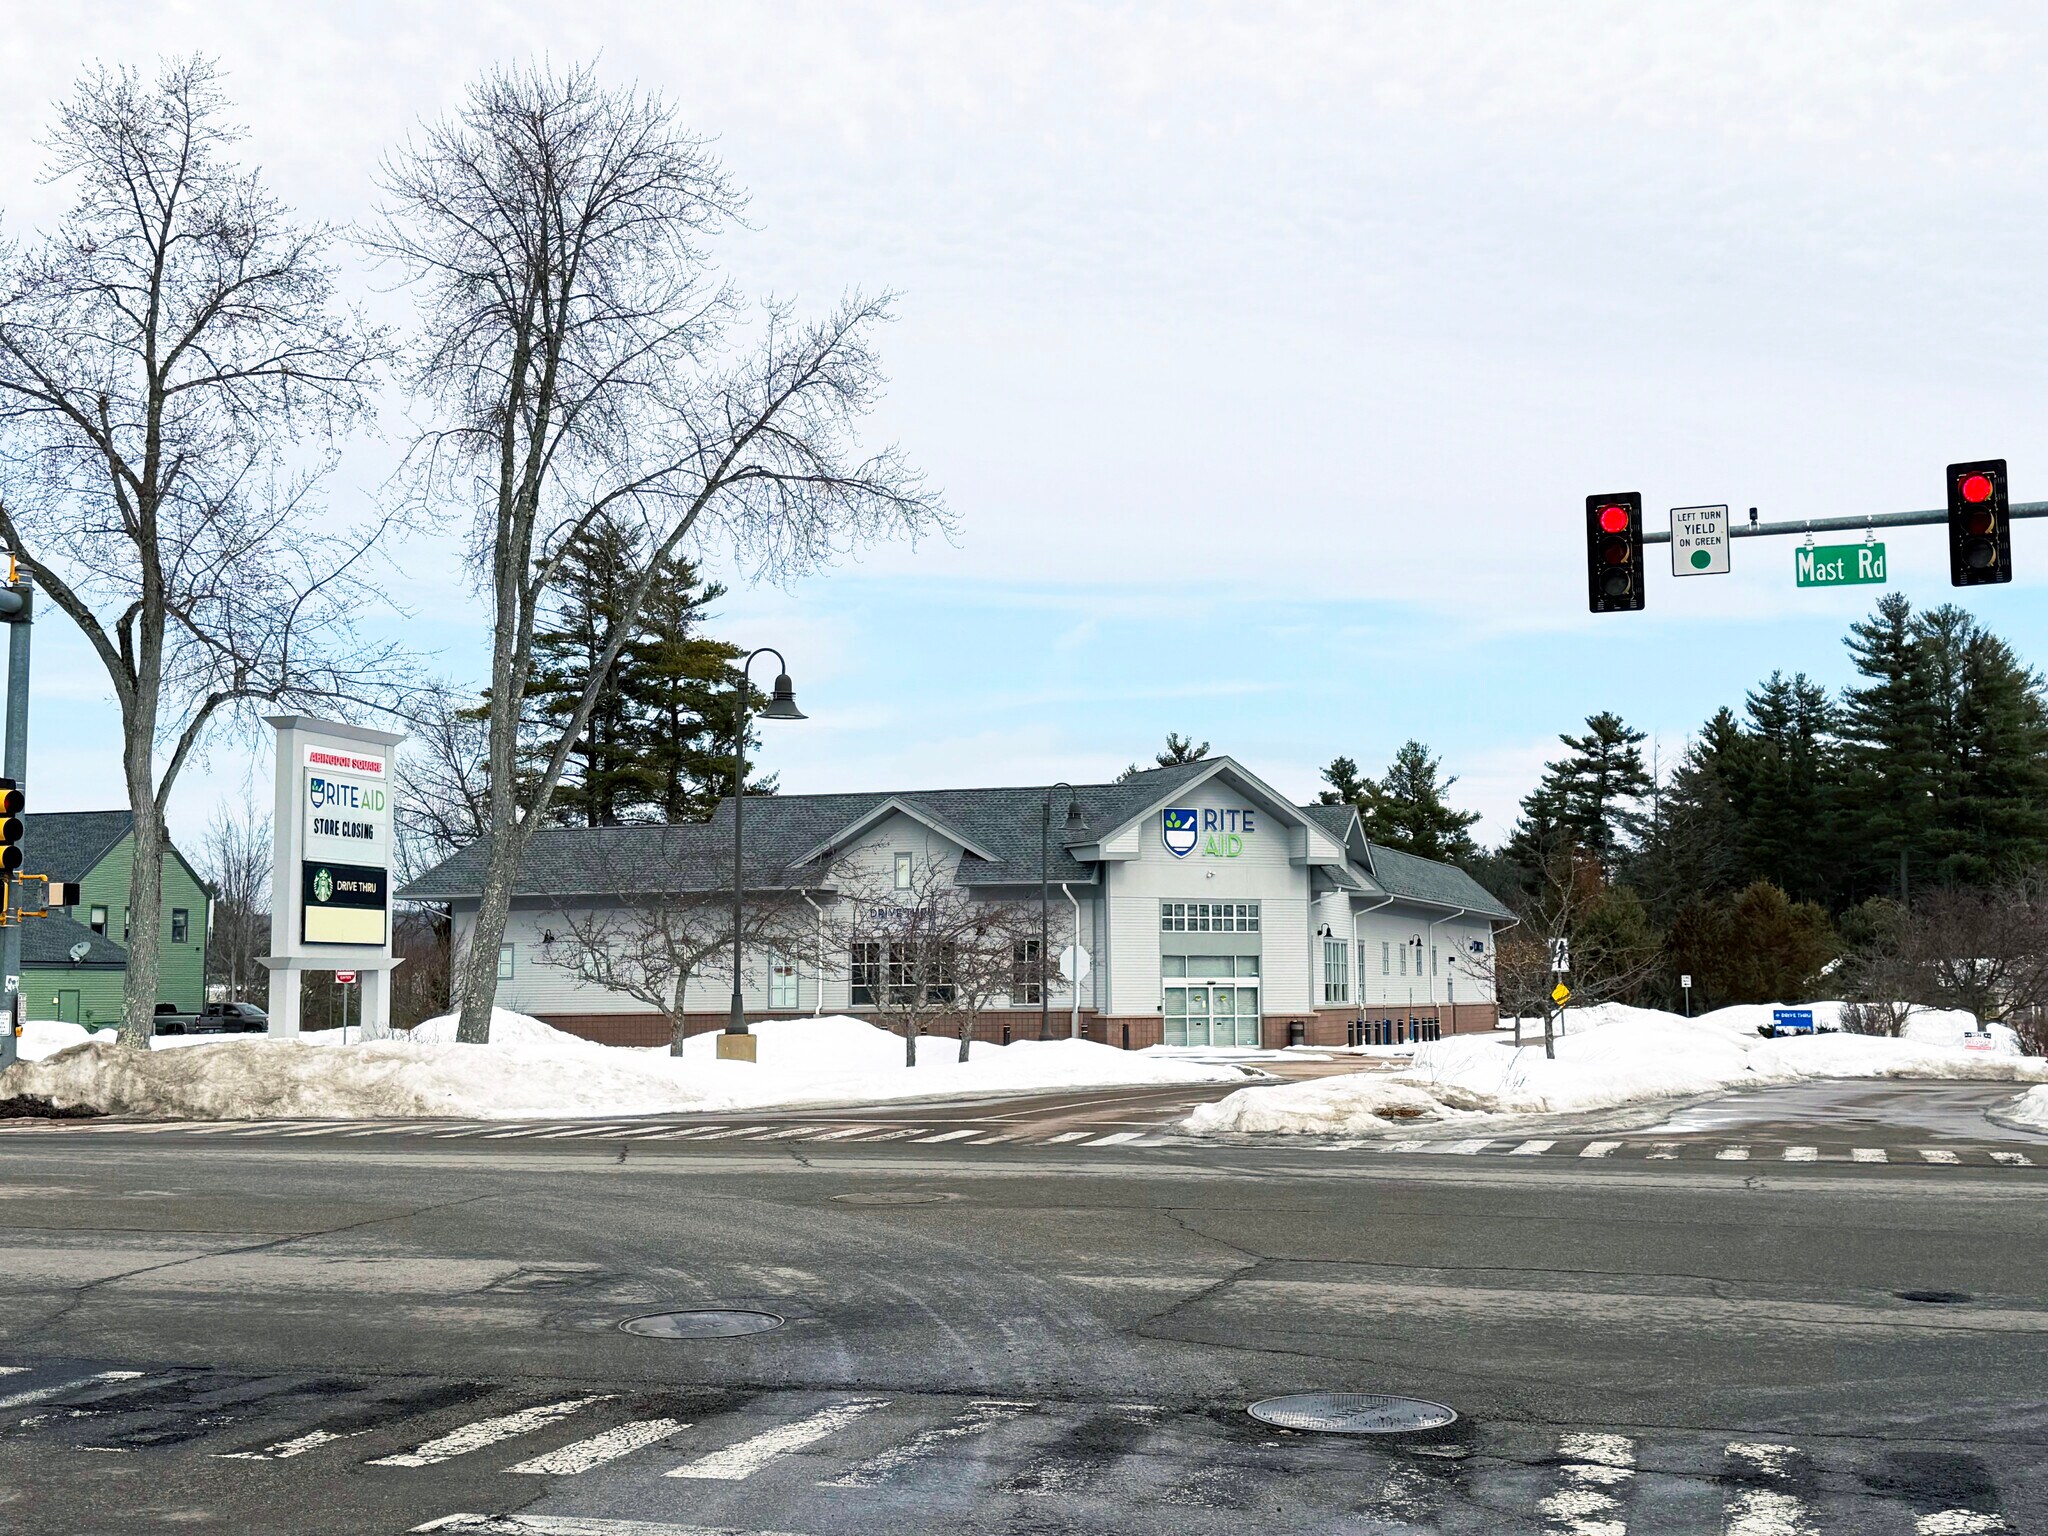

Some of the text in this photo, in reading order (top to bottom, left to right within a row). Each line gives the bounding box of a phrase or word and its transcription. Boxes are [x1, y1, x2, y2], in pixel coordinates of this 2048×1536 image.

[1677, 510, 1721, 522] LEFT TURN
[1684, 522, 1716, 535] YIELD
[1679, 536, 1721, 547] ON GREEN
[1798, 548, 1884, 582] Mast Rd
[310, 752, 382, 773] ABINGDON SQUARE
[327, 783, 385, 812] RITE AID
[313, 818, 374, 840] STORE CLOSING
[1203, 808, 1255, 832] RITE
[1202, 834, 1243, 857] AID
[336, 880, 377, 893] DRIVE THRU
[870, 907, 903, 919] DRIVE
